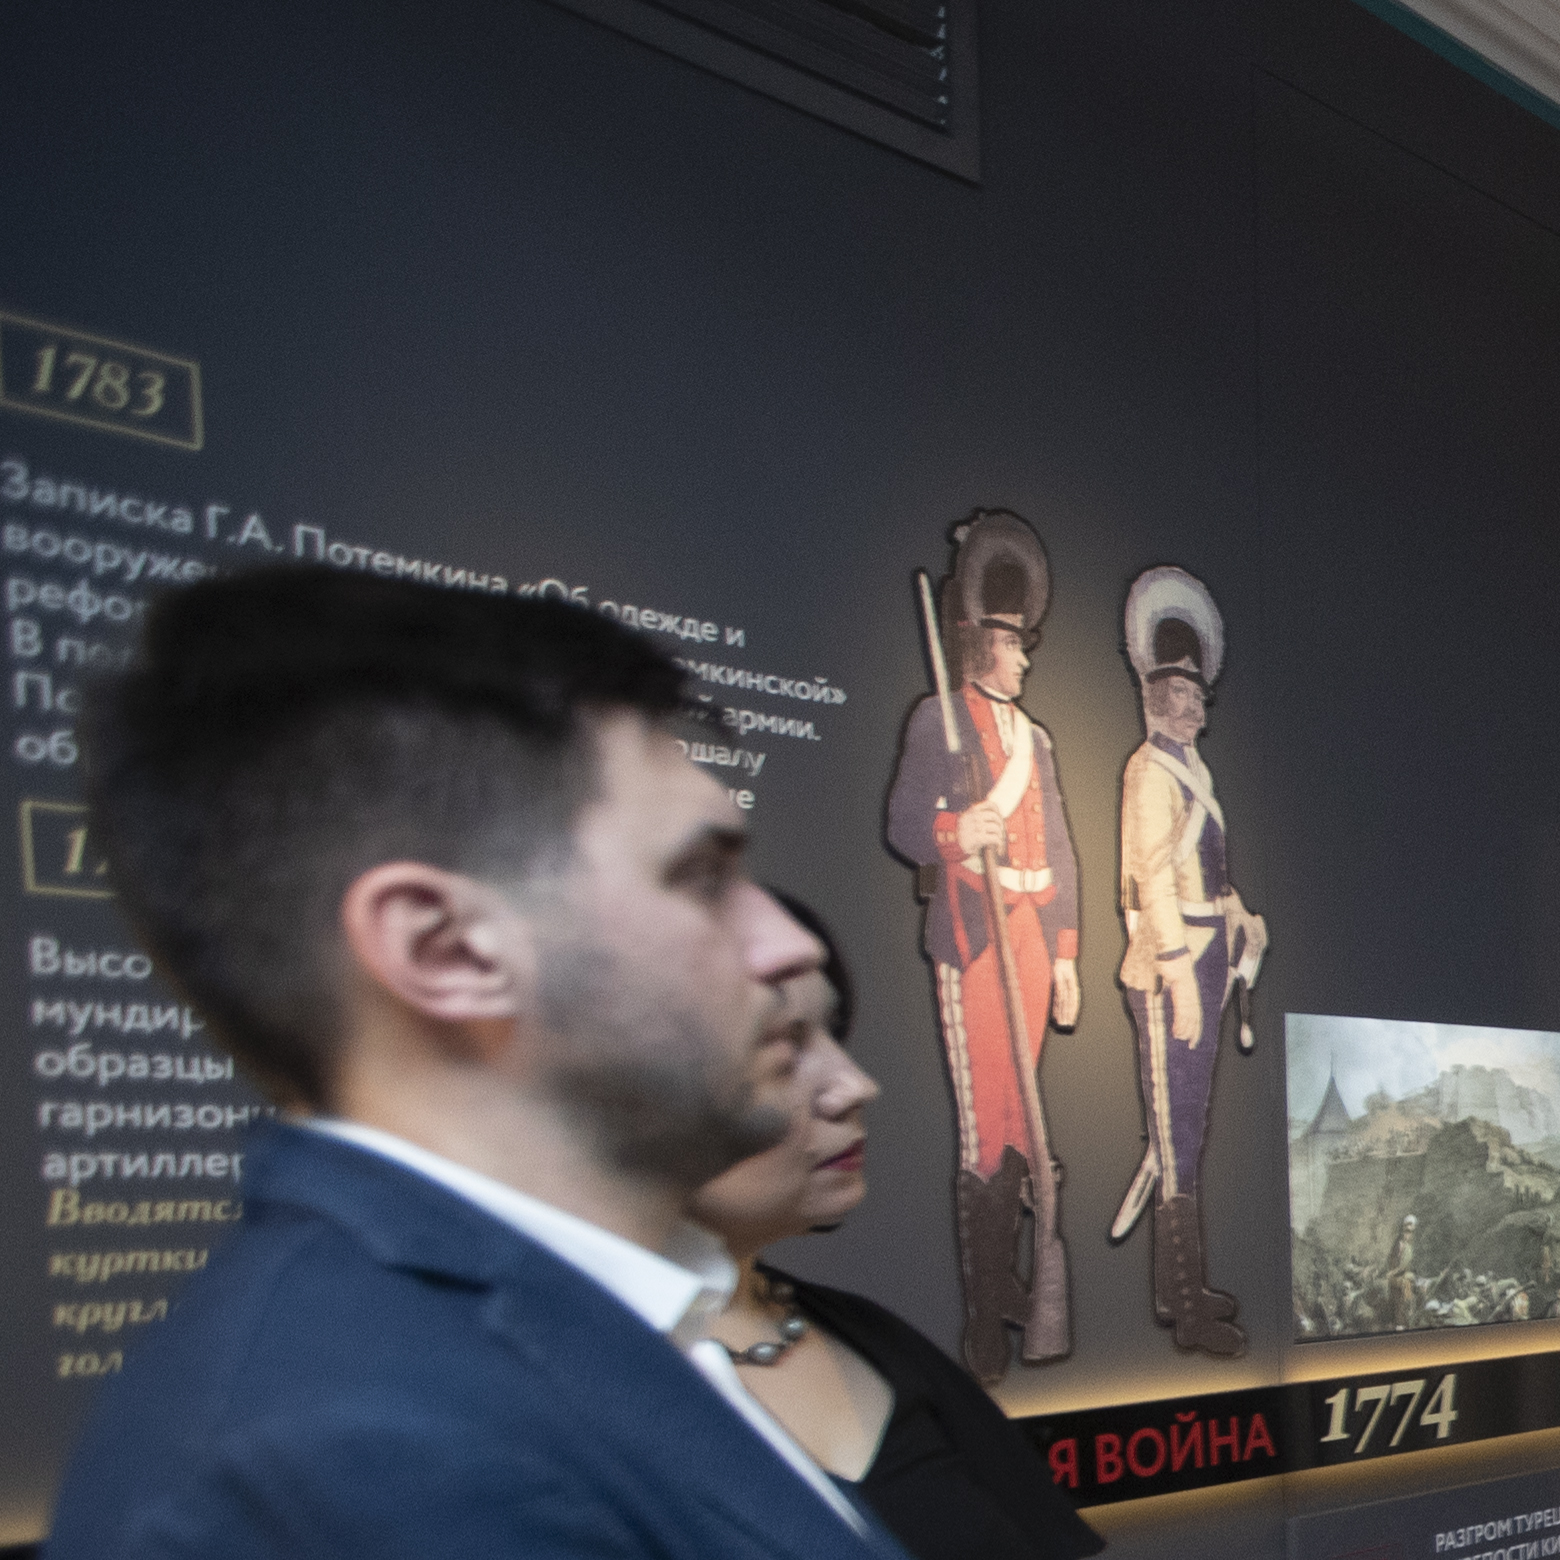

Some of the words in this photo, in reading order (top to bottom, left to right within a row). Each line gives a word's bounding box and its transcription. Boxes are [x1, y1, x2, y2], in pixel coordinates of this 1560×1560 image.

[32, 345, 167, 417] 1783
[0, 460, 193, 533] Записка
[206, 503, 285, 552] Г.А.
[725, 625, 746, 648] и
[2, 523, 215, 581] вооруже
[10, 617, 43, 657] В
[35, 1041, 234, 1087] образцы
[1320, 1374, 1459, 1454] 1774
[1096, 1411, 1276, 1485] ВОЙНА
[1435, 1519, 1512, 1553] РАЗГРОМ
